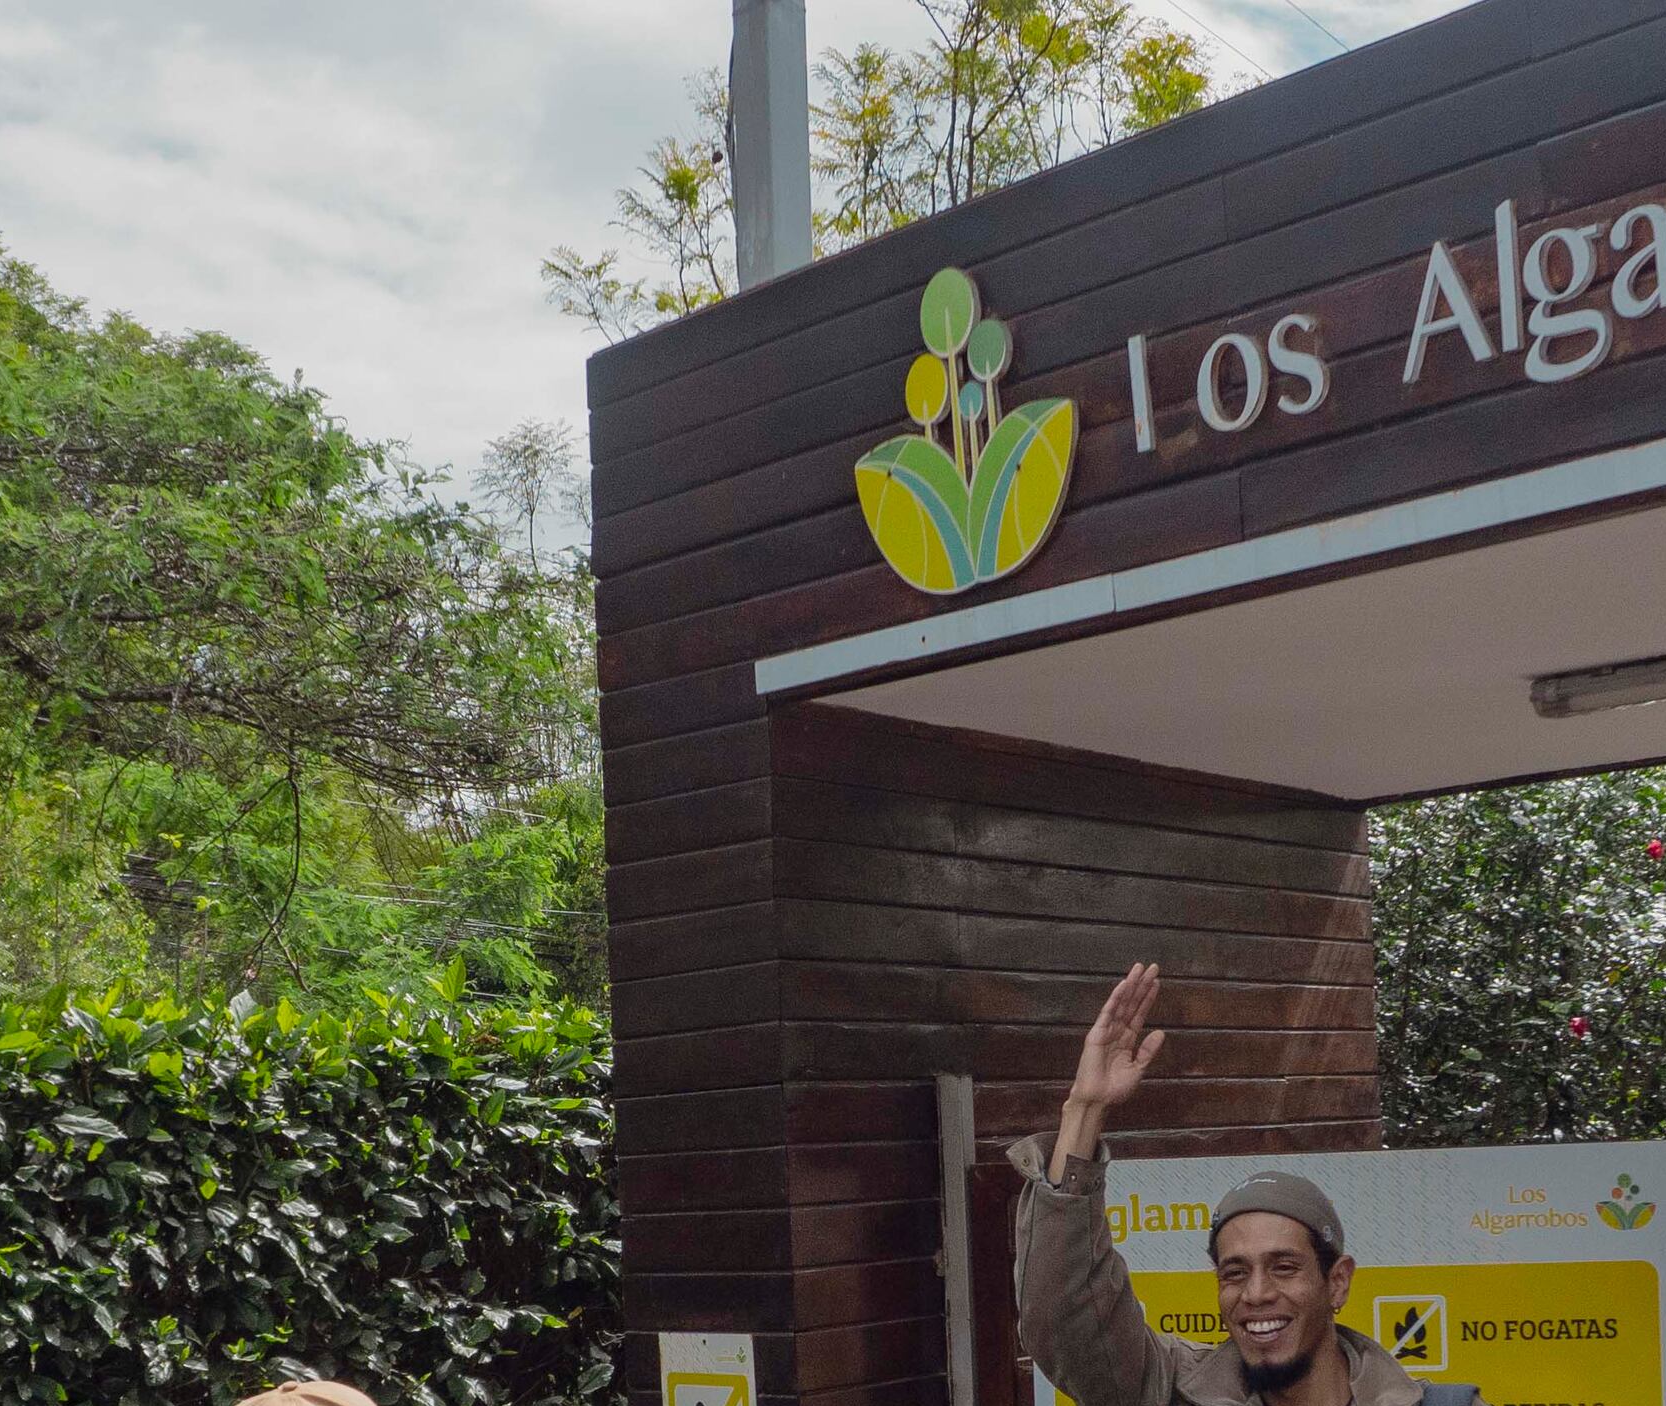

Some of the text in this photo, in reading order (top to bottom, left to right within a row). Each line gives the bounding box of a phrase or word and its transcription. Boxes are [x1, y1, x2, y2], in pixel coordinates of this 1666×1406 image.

[1507, 1184, 1547, 1205] Los
[1105, 1193, 1214, 1245] glam
[1469, 1207, 1589, 1236] Algarrobos
[1461, 1318, 1619, 1342] NO FOGATAS
